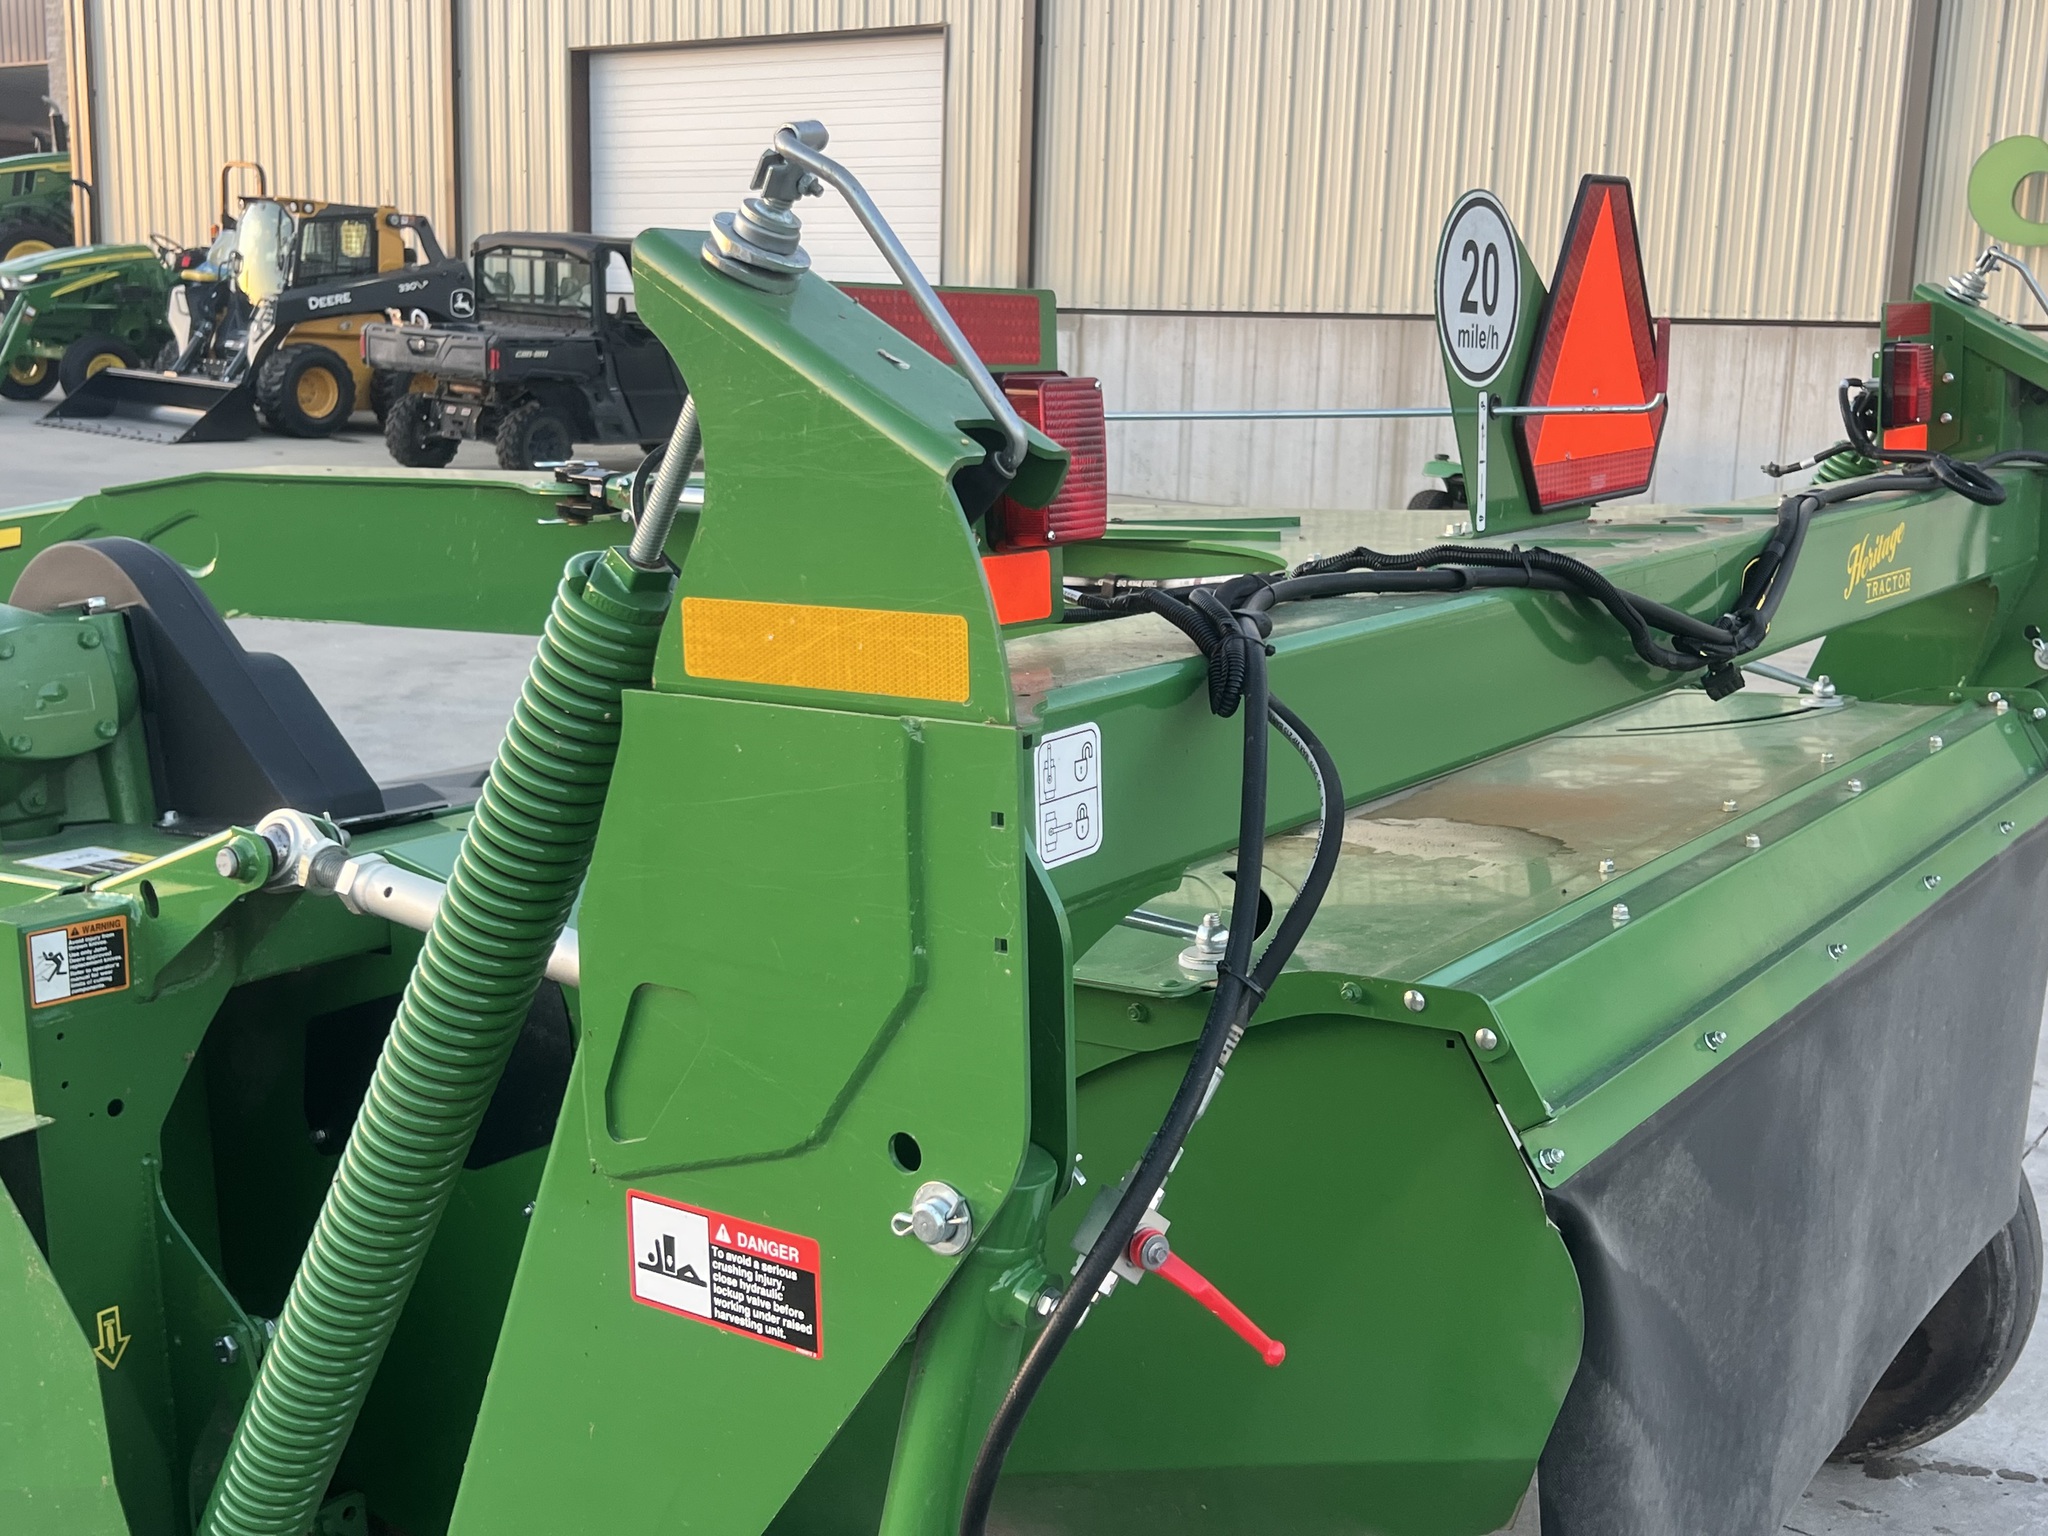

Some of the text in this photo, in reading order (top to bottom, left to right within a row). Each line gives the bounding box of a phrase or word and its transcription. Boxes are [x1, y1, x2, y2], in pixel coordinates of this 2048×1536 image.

[1459, 239, 1500, 316] 20
[307, 291, 352, 310] DEERE
[1457, 324, 1499, 350] mile/h
[1844, 522, 1905, 600] Heritage
[1866, 572, 1911, 599] TRACTOR
[82, 919, 121, 934] WARNING
[737, 1232, 800, 1263] DANGER
[712, 1246, 798, 1281] To avoid a serious
[712, 1260, 786, 1291] crushing injury,
[712, 1272, 784, 1302] close hydraulic
[713, 1283, 804, 1321] lockup valve before
[713, 1297, 812, 1335] working under raised
[714, 1308, 787, 1340] harvesting unit.
